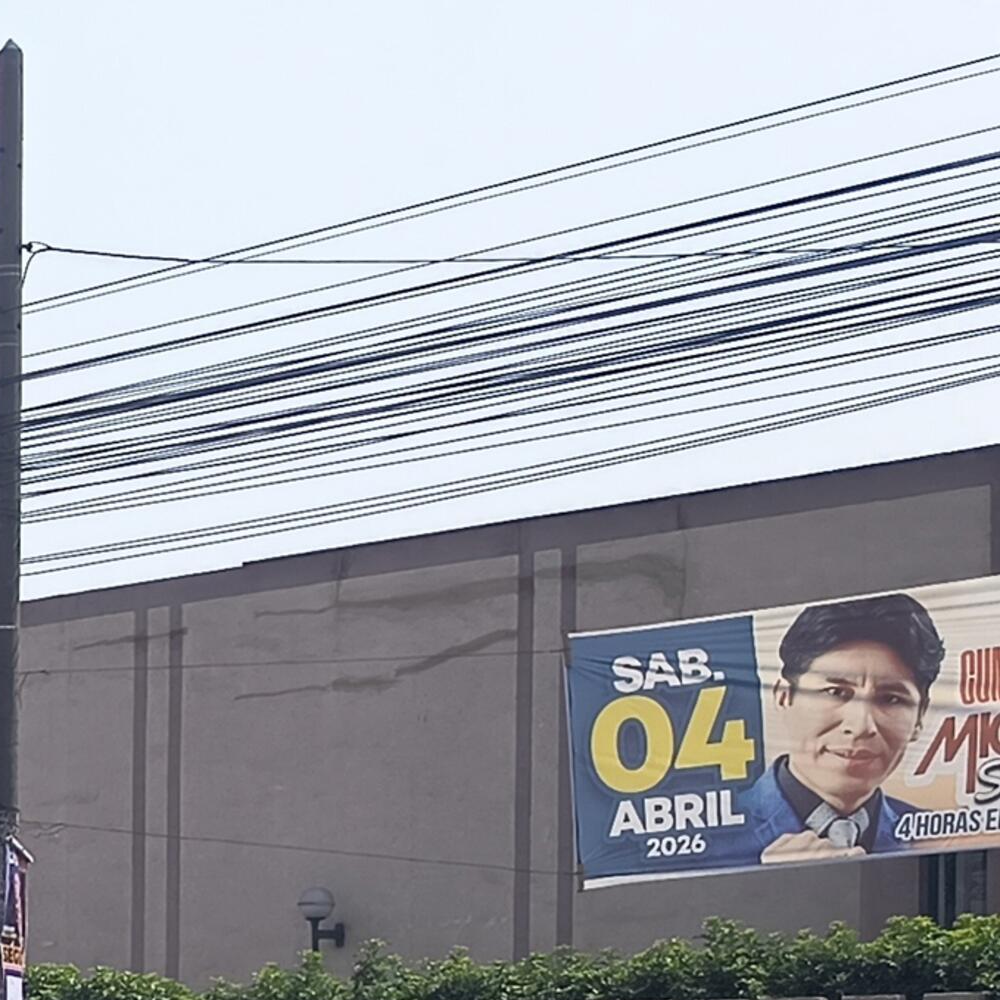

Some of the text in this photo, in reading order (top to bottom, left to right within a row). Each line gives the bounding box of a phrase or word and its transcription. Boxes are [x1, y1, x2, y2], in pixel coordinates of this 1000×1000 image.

[612, 648, 726, 692] SAB.
[591, 685, 755, 794] 04
[609, 791, 745, 837] ABRIL
[899, 815, 911, 838] 4
[916, 810, 980, 837] HORAS
[647, 834, 706, 858] 2026
